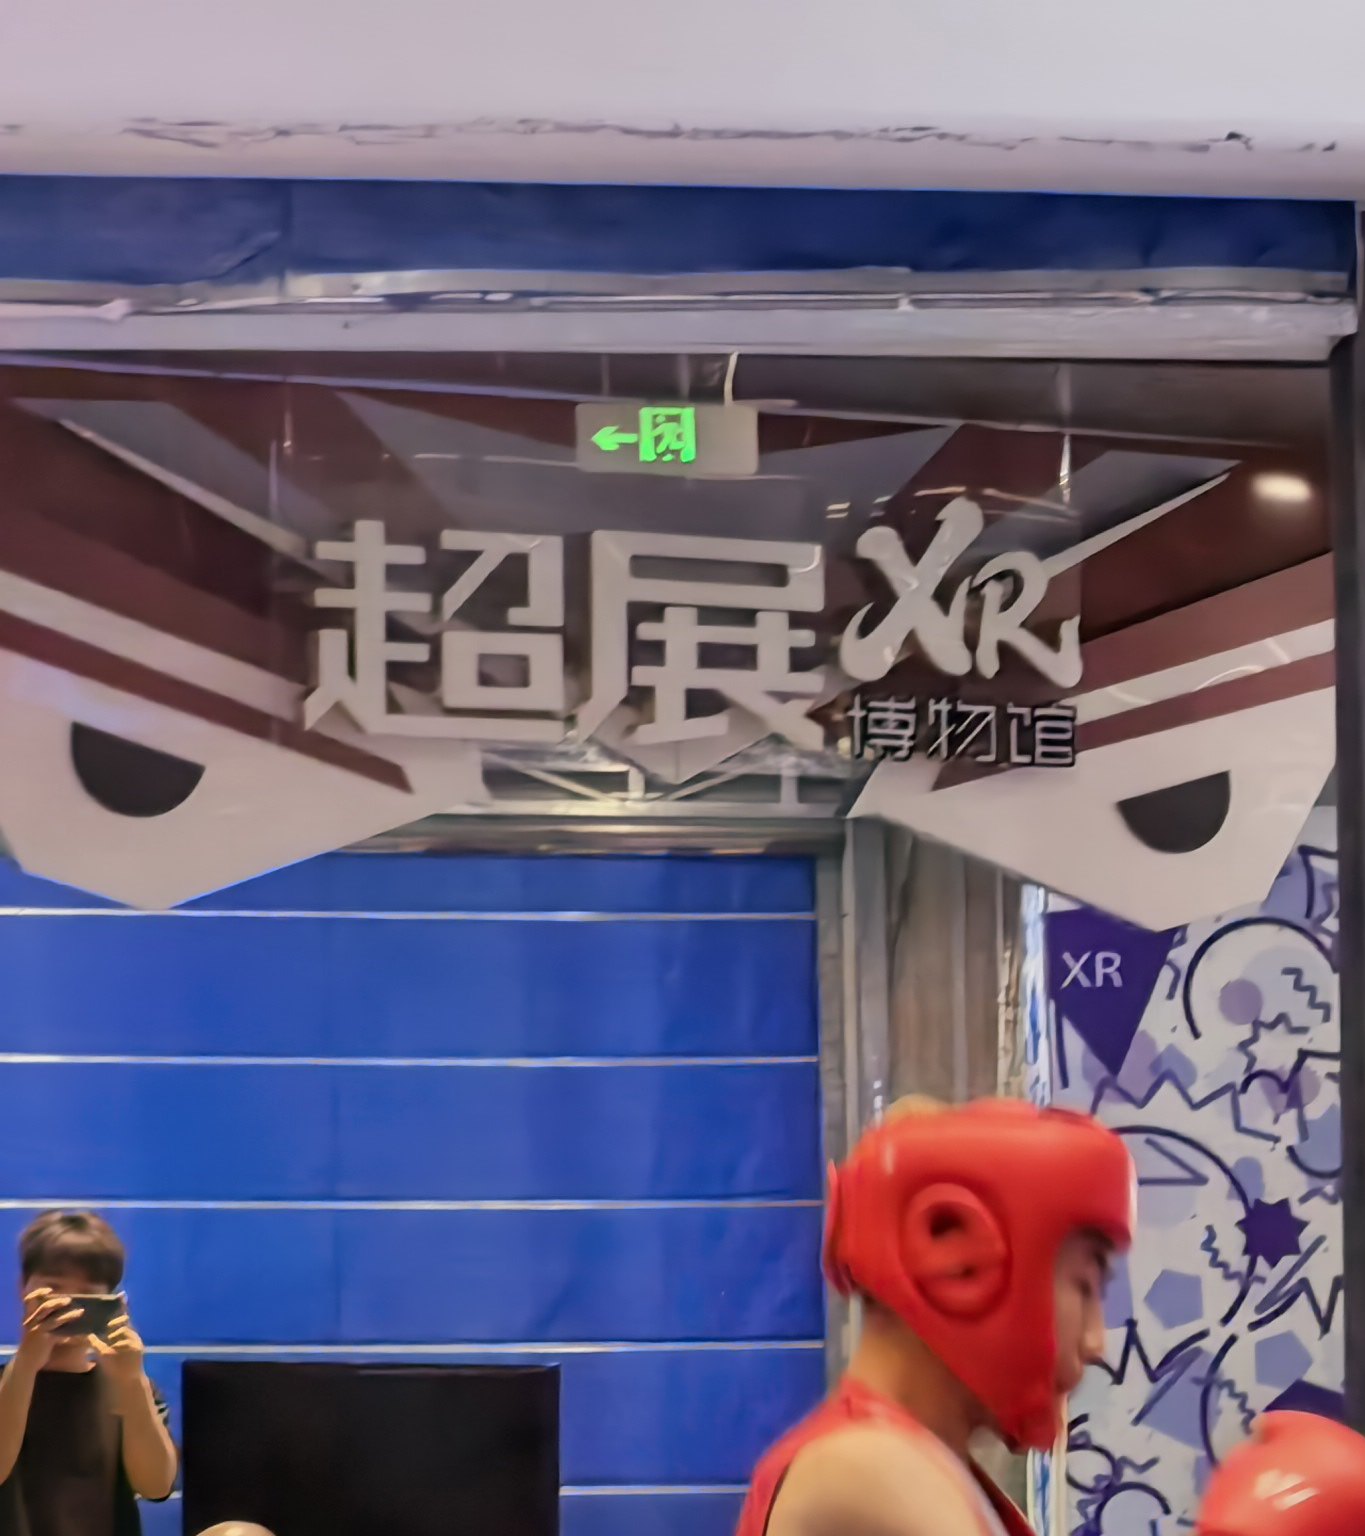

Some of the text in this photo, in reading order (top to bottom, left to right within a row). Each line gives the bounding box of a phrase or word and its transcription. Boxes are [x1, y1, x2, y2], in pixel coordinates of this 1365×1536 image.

[847, 694, 1077, 767] 博物馆
[1060, 951, 1123, 990] XR
